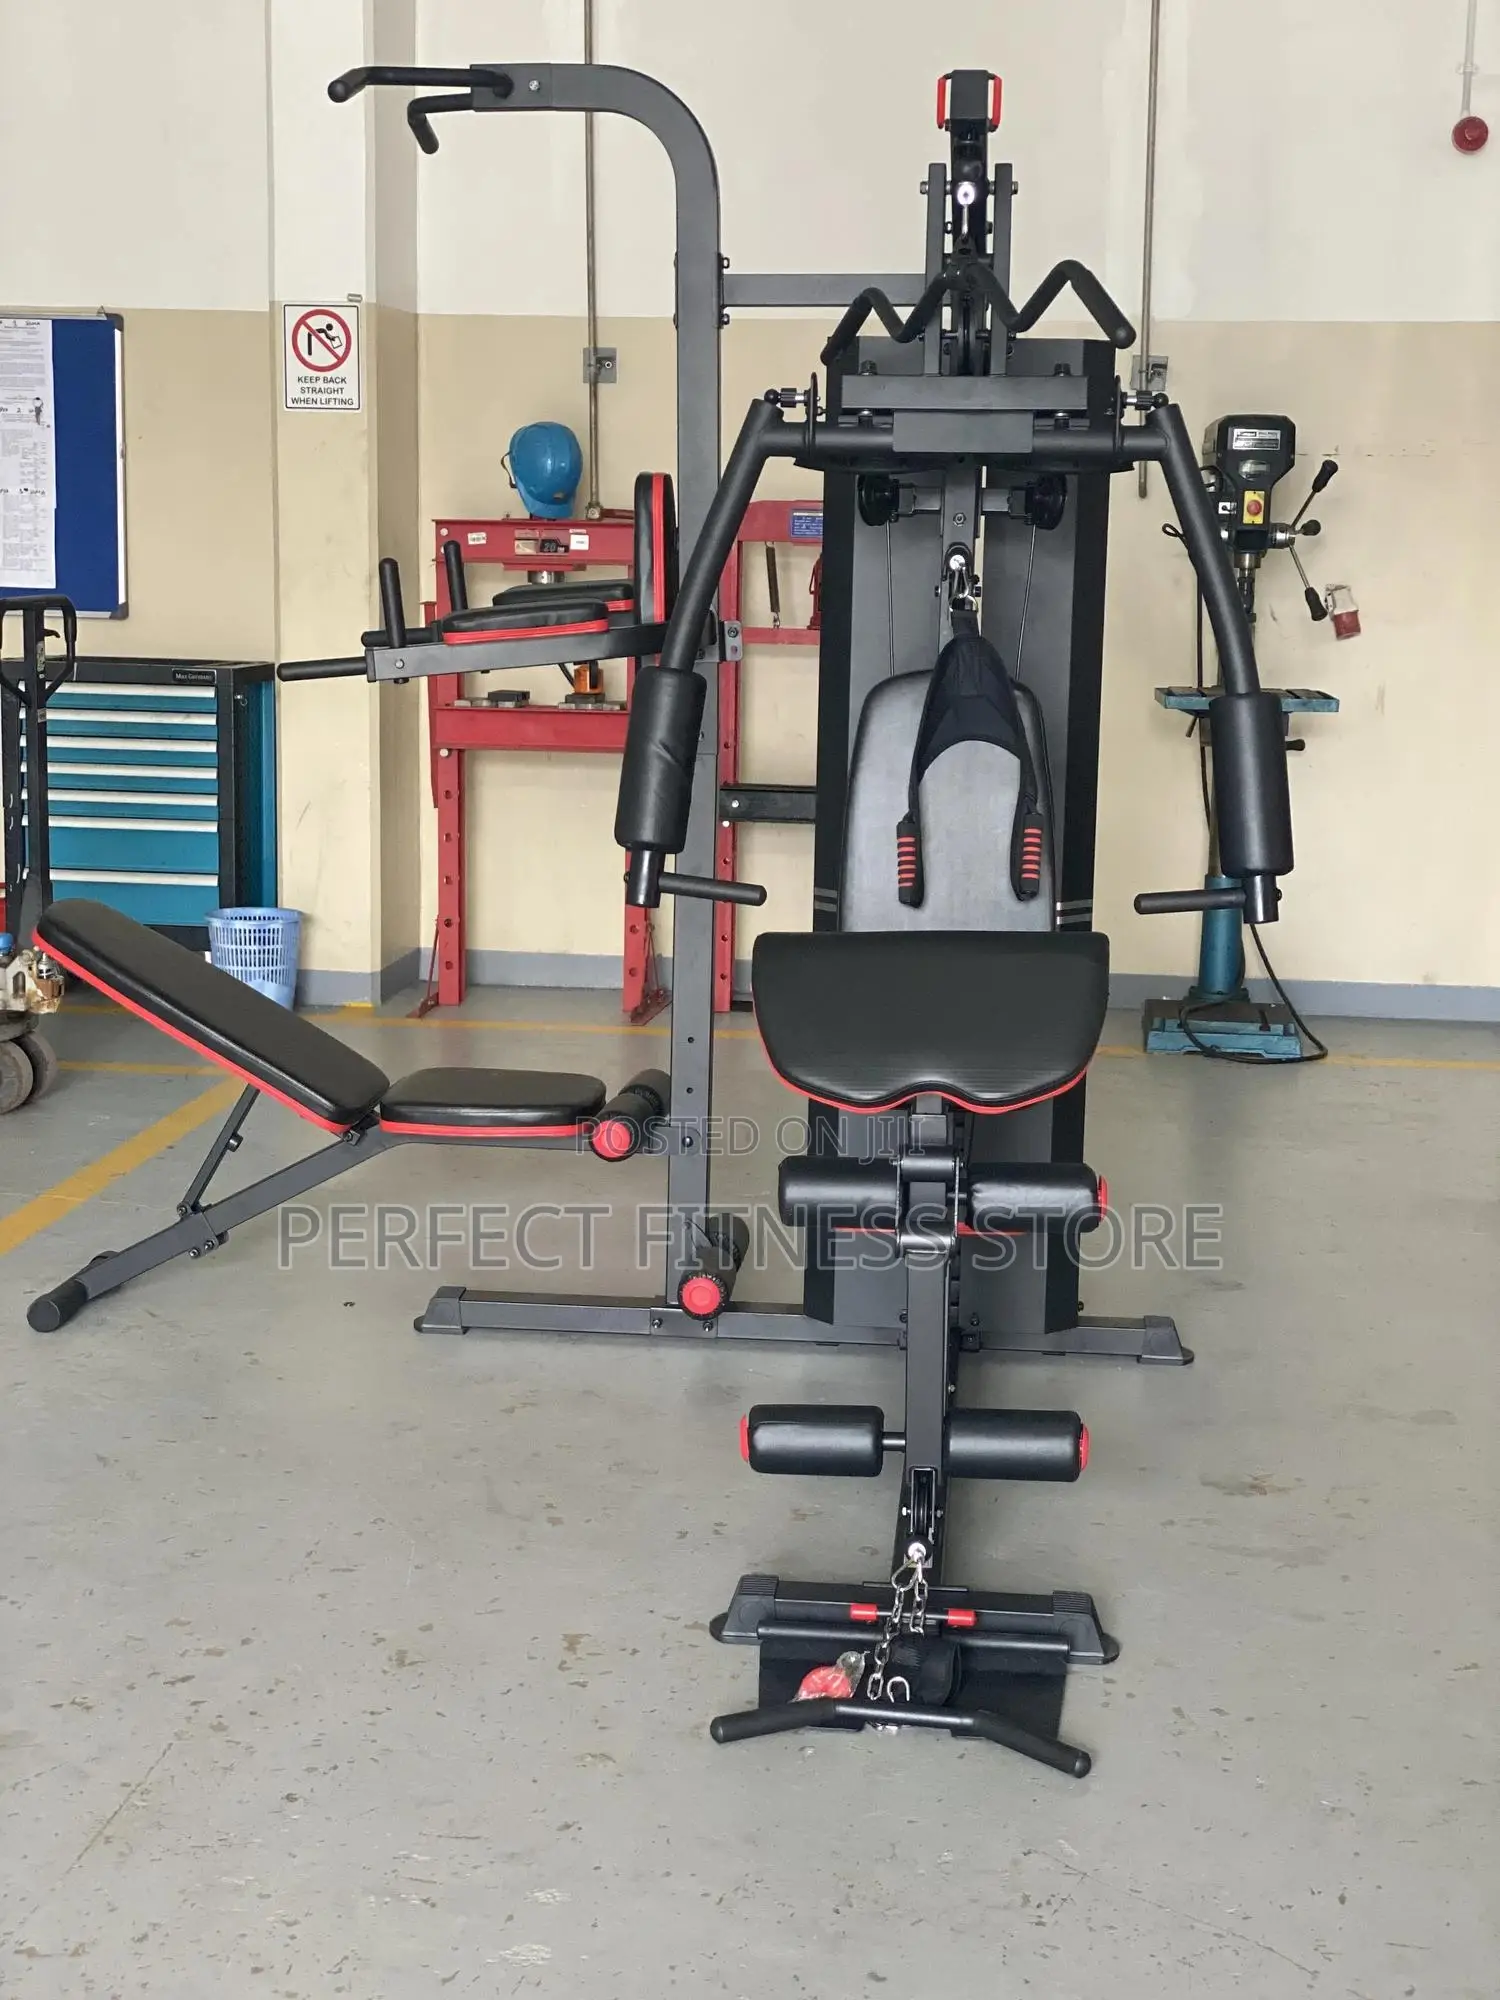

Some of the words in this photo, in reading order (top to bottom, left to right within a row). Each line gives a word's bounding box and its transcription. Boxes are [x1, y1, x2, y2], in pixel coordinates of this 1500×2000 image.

[297, 376, 320, 384] KEEP
[323, 376, 347, 384] BACK
[300, 386, 344, 395] STRAIGHT
[291, 397, 318, 405] WHEN
[320, 397, 354, 406] LIFTING
